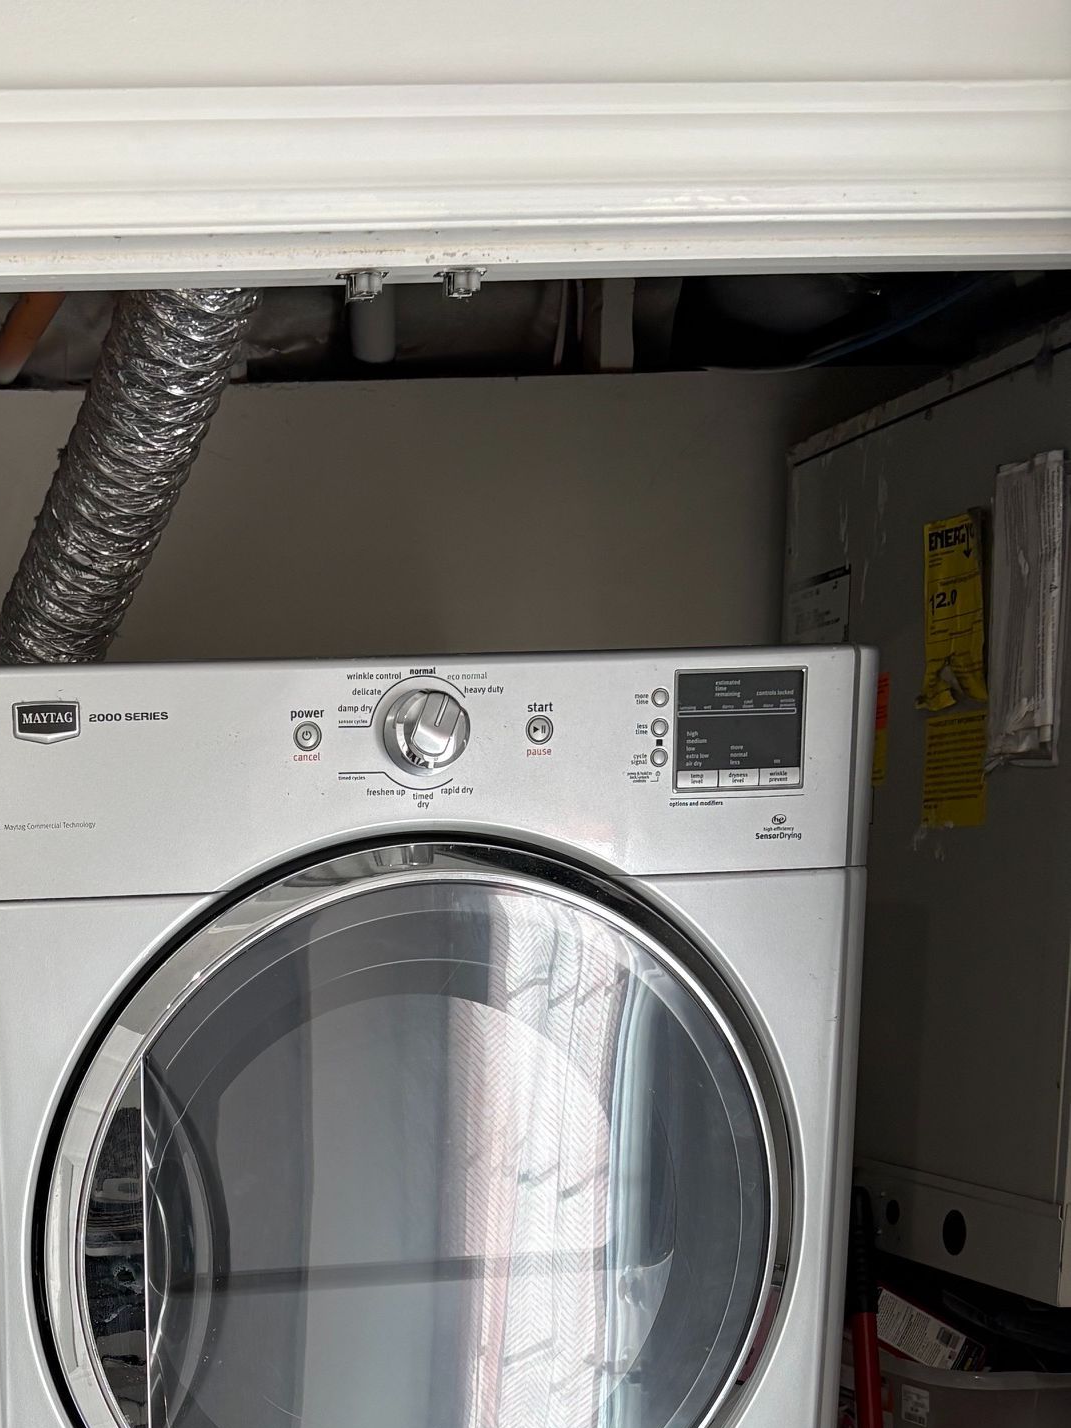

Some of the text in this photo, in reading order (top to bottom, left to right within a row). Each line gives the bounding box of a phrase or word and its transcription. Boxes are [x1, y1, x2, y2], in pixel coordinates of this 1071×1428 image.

[347, 671, 402, 680] wrinkle control
[409, 667, 436, 675] normal
[461, 672, 487, 680] normal
[352, 687, 382, 696] delicate
[464, 685, 504, 695] heavy duty
[338, 704, 373, 713] damp dry
[527, 702, 553, 712] start
[22, 711, 169, 724] MAYTAG 2000 SERIES
[290, 708, 325, 721] power
[526, 747, 552, 757] pause
[293, 752, 321, 762] cancel
[366, 788, 394, 796] freshen
[441, 786, 474, 795] rapid dry
[412, 792, 434, 801] timed
[417, 801, 430, 809] dry
[4, 823, 26, 831] Maytag
[27, 822, 61, 830] Commercial
[63, 821, 96, 829] Technology
[755, 832, 802, 840] SensorDrying
